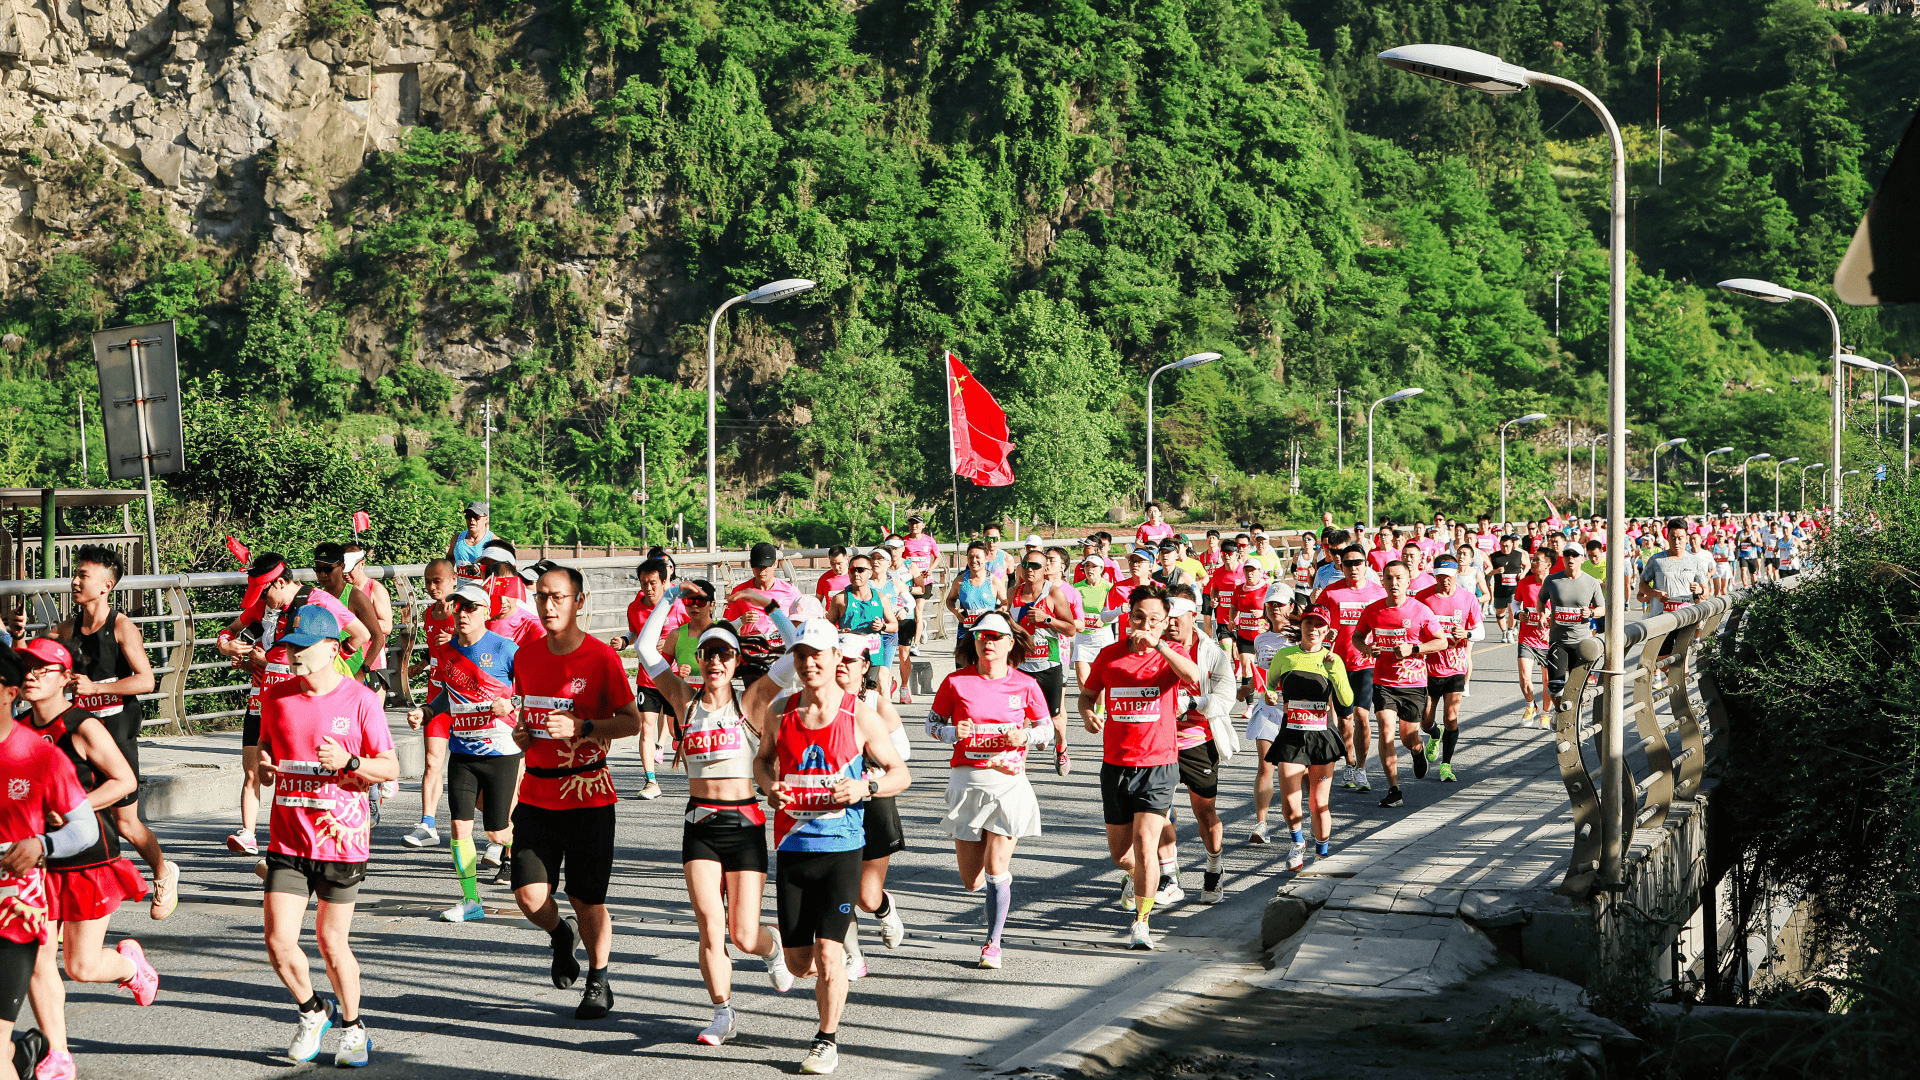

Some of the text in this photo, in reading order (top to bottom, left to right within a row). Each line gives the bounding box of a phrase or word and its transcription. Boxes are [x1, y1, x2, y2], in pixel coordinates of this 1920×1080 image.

[1342, 610, 1362, 618] A123
[78, 695, 118, 708] A10134
[1114, 700, 1157, 711] A11877
[454, 715, 491, 727] A11737
[527, 711, 547, 725] A12
[688, 732, 736, 750] A20109
[279, 778, 330, 794] A11831
